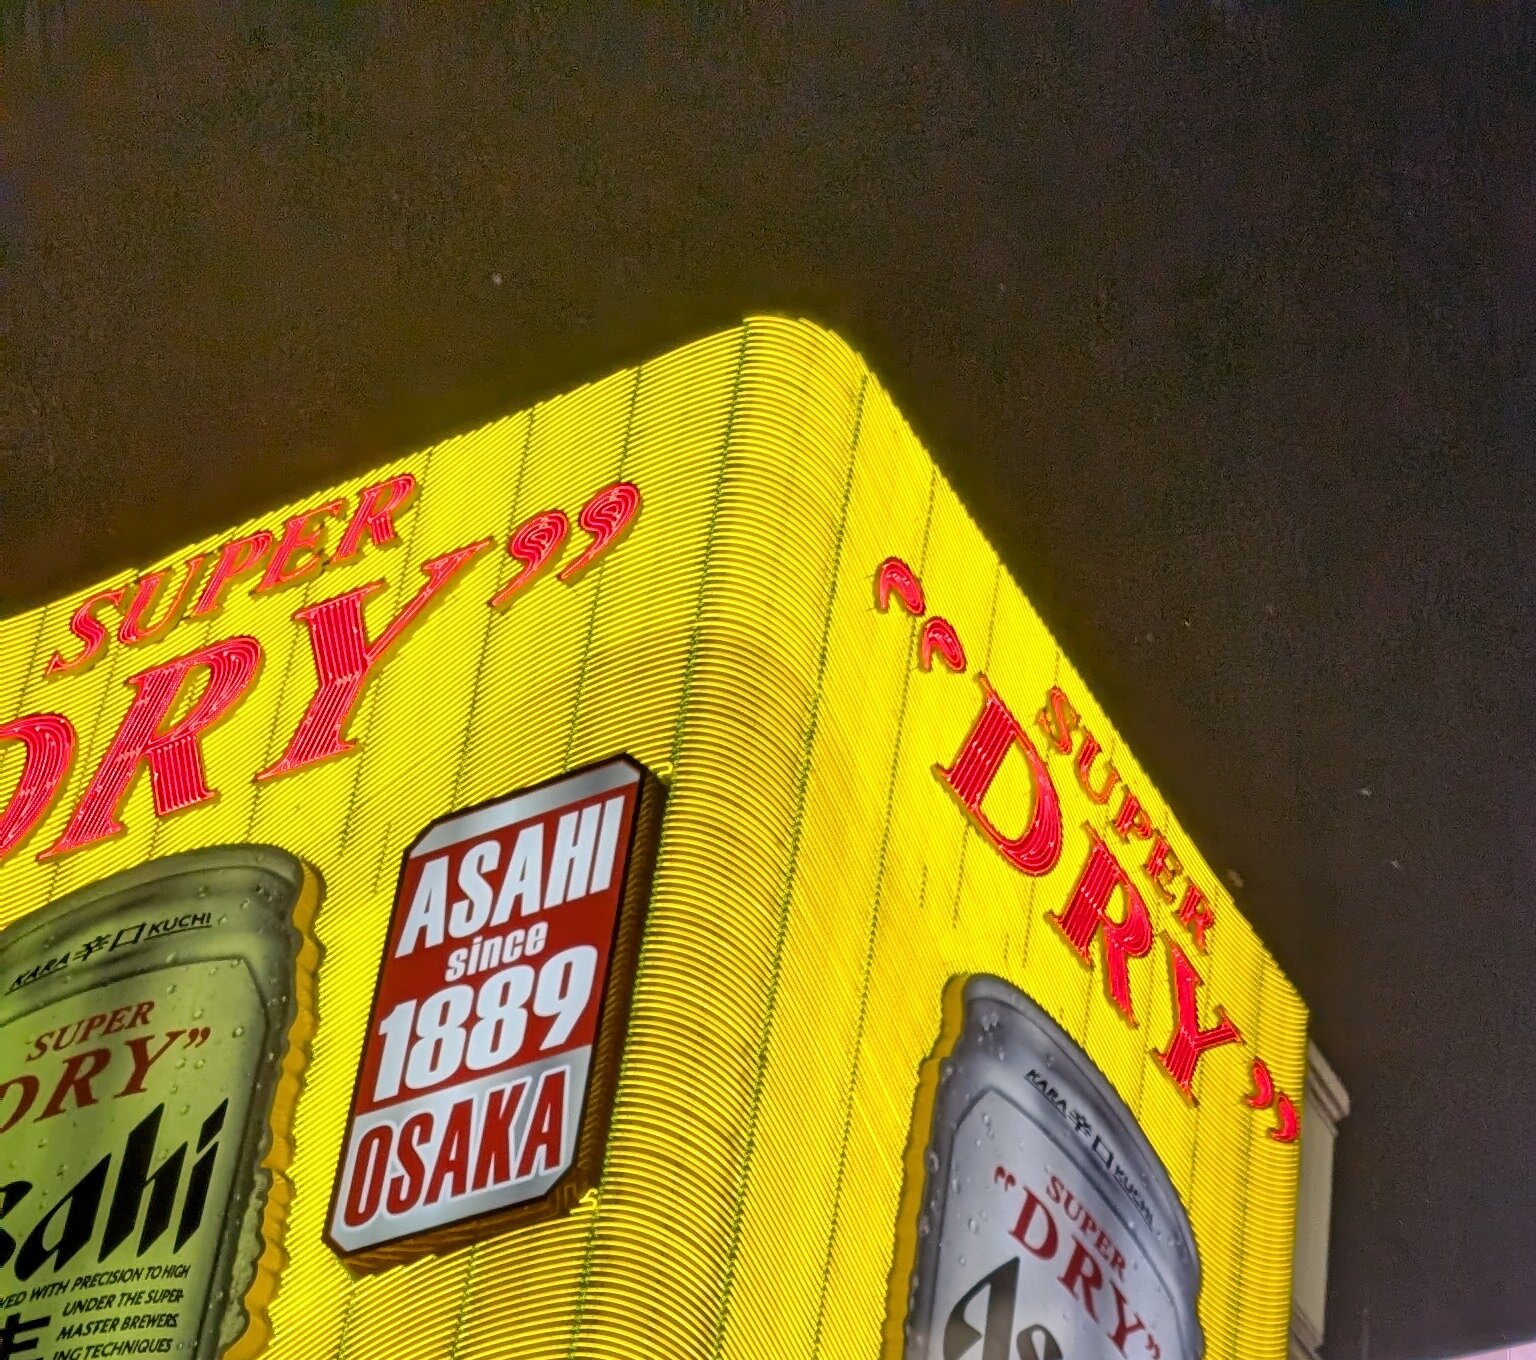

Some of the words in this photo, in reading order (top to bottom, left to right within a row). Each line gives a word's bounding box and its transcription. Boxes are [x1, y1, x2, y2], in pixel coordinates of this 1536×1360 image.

[46, 472, 415, 676] SUPER
[1036, 686, 1214, 951] SUPER
[395, 794, 624, 958] ASAHI
[6, 953, 70, 991] KARA
[148, 912, 212, 937] KUCHI
[446, 920, 546, 981] since
[25, 1001, 155, 1062] SUPER
[374, 946, 600, 1102] 1889
[1028, 1069, 1067, 1114] KARA
[343, 1067, 571, 1228] OSAKA
[1046, 1175, 1127, 1280] SUPER
[29, 1280, 70, 1302] WITH
[71, 1268, 144, 1292] PRECISION
[145, 1265, 162, 1280] TO
[163, 1264, 191, 1278] HIGH
[62, 1294, 116, 1316] UNDER
[118, 1291, 143, 1307] THE
[56, 1317, 120, 1340] MASTER
[121, 1313, 179, 1329] BREWERS
[84, 1339, 173, 1360] TECHNIQUES
